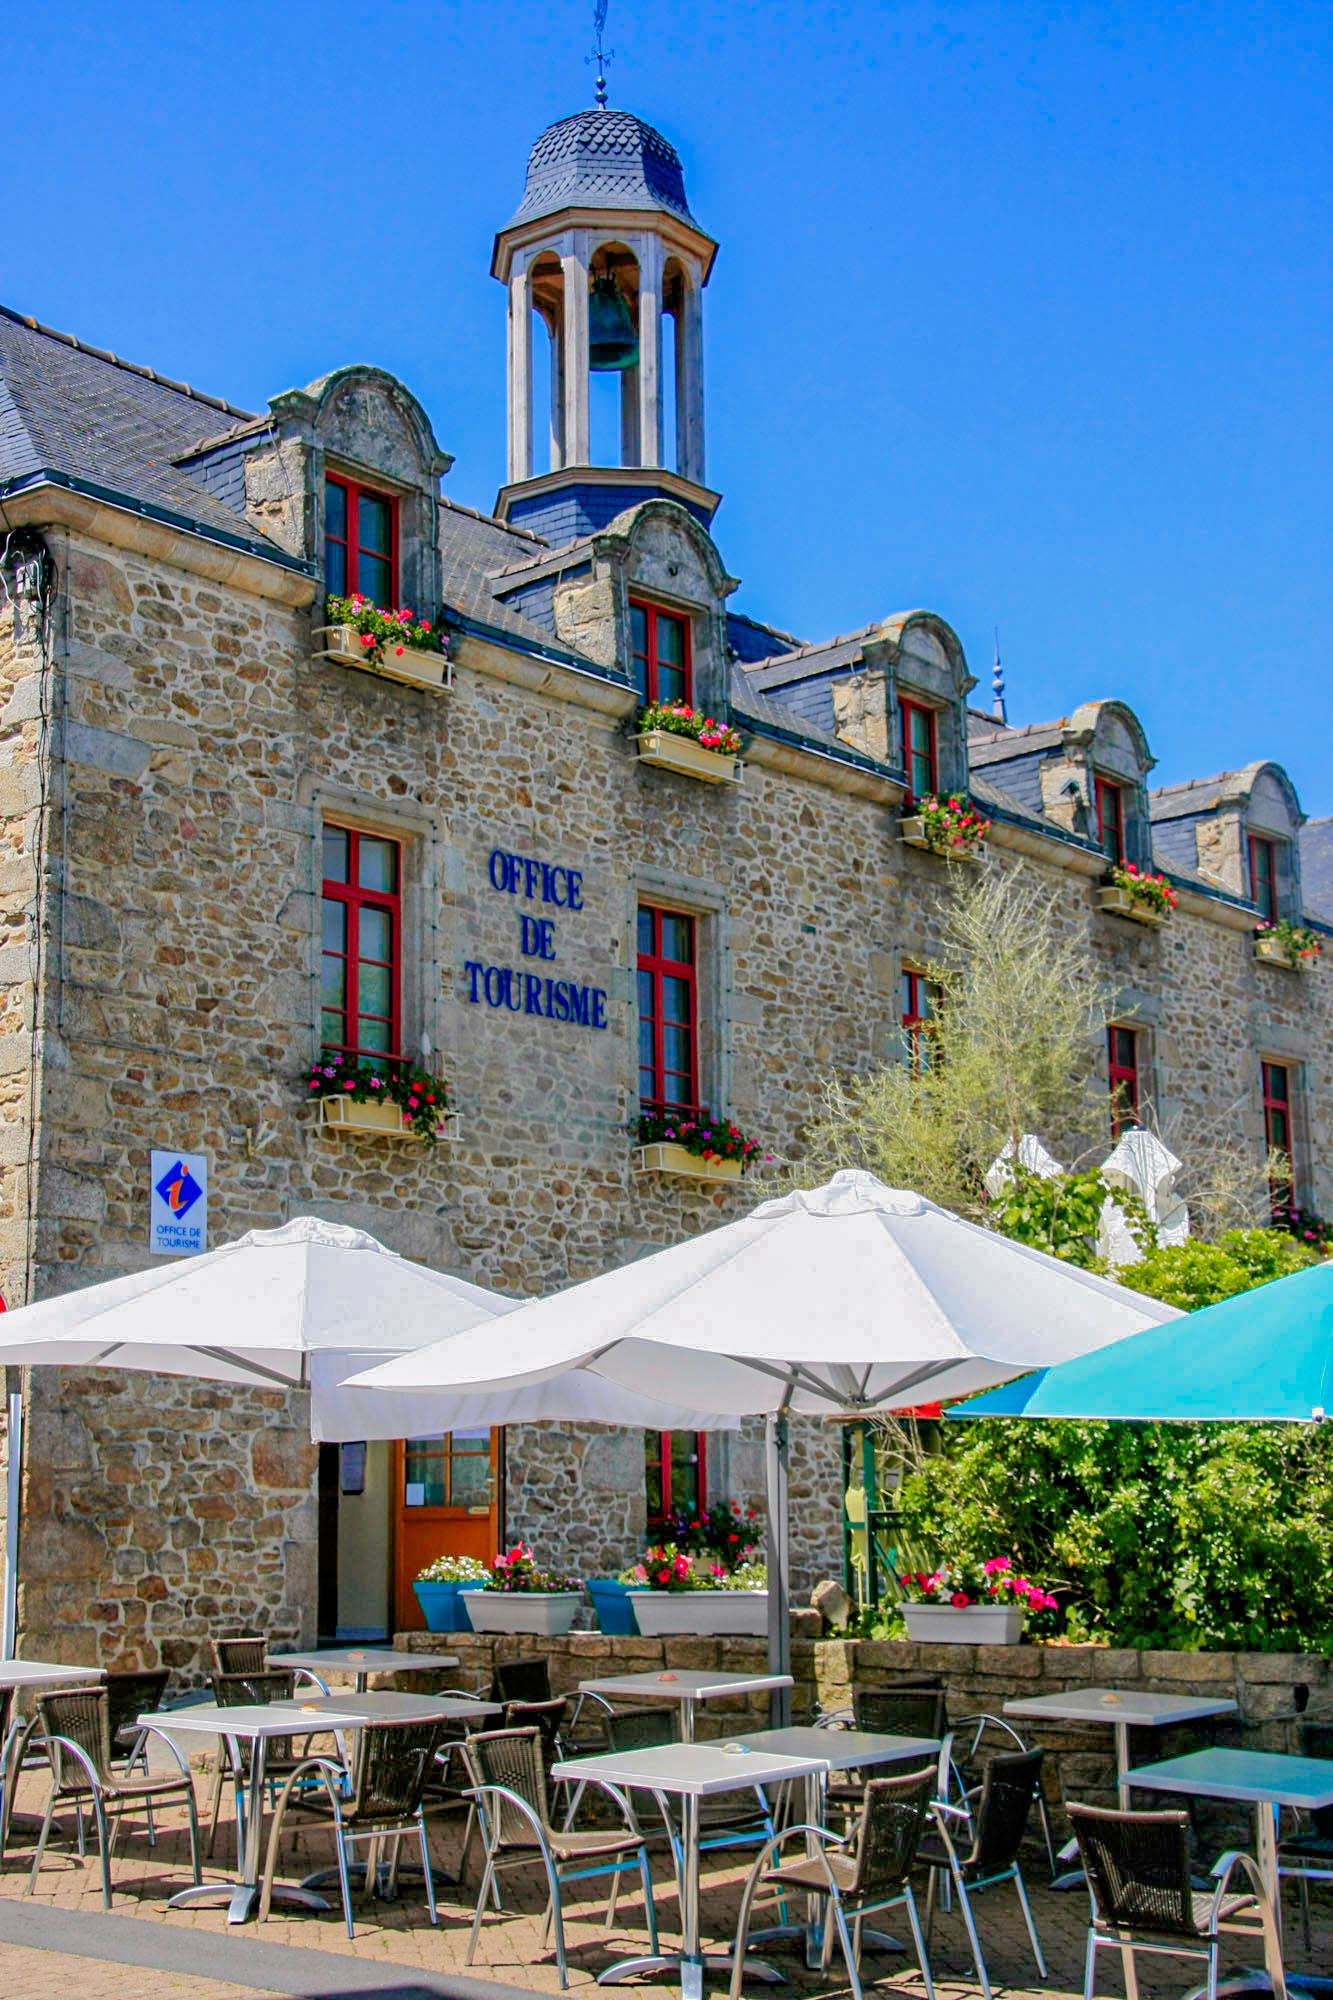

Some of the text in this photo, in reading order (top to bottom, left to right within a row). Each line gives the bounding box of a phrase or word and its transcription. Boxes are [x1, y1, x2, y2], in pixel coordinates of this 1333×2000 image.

[489, 850, 584, 911] OFFICE
[520, 914, 556, 960] DE
[465, 960, 608, 1029] TOURISME
[156, 1225, 200, 1237] OFFICE DE
[157, 1237, 200, 1248] TOURISME
